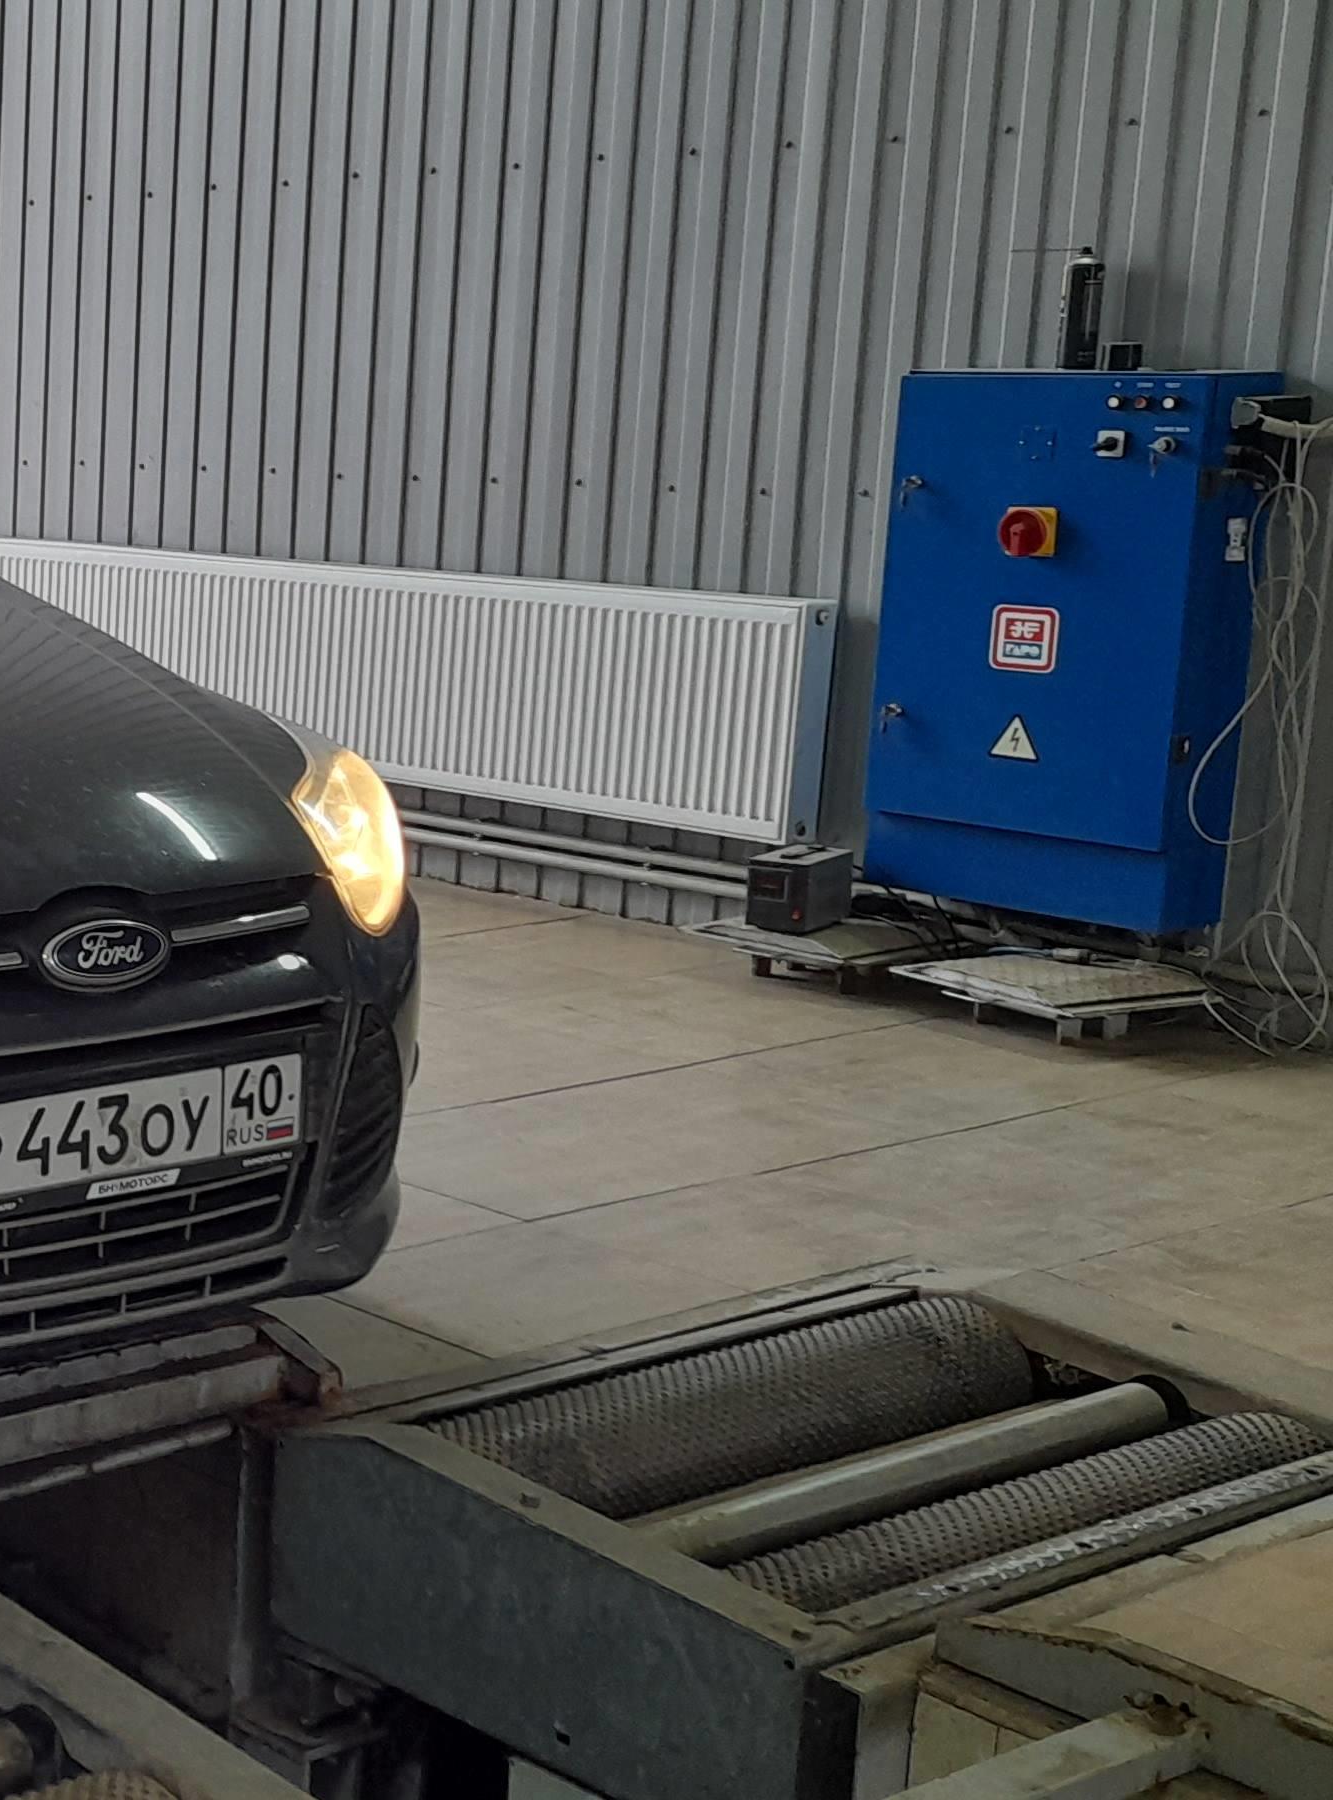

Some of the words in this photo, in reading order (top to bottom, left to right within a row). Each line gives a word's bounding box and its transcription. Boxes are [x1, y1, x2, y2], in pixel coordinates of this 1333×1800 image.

[77, 930, 144, 969] Ford
[231, 1064, 283, 1121] 40
[226, 1123, 264, 1148] RUS
